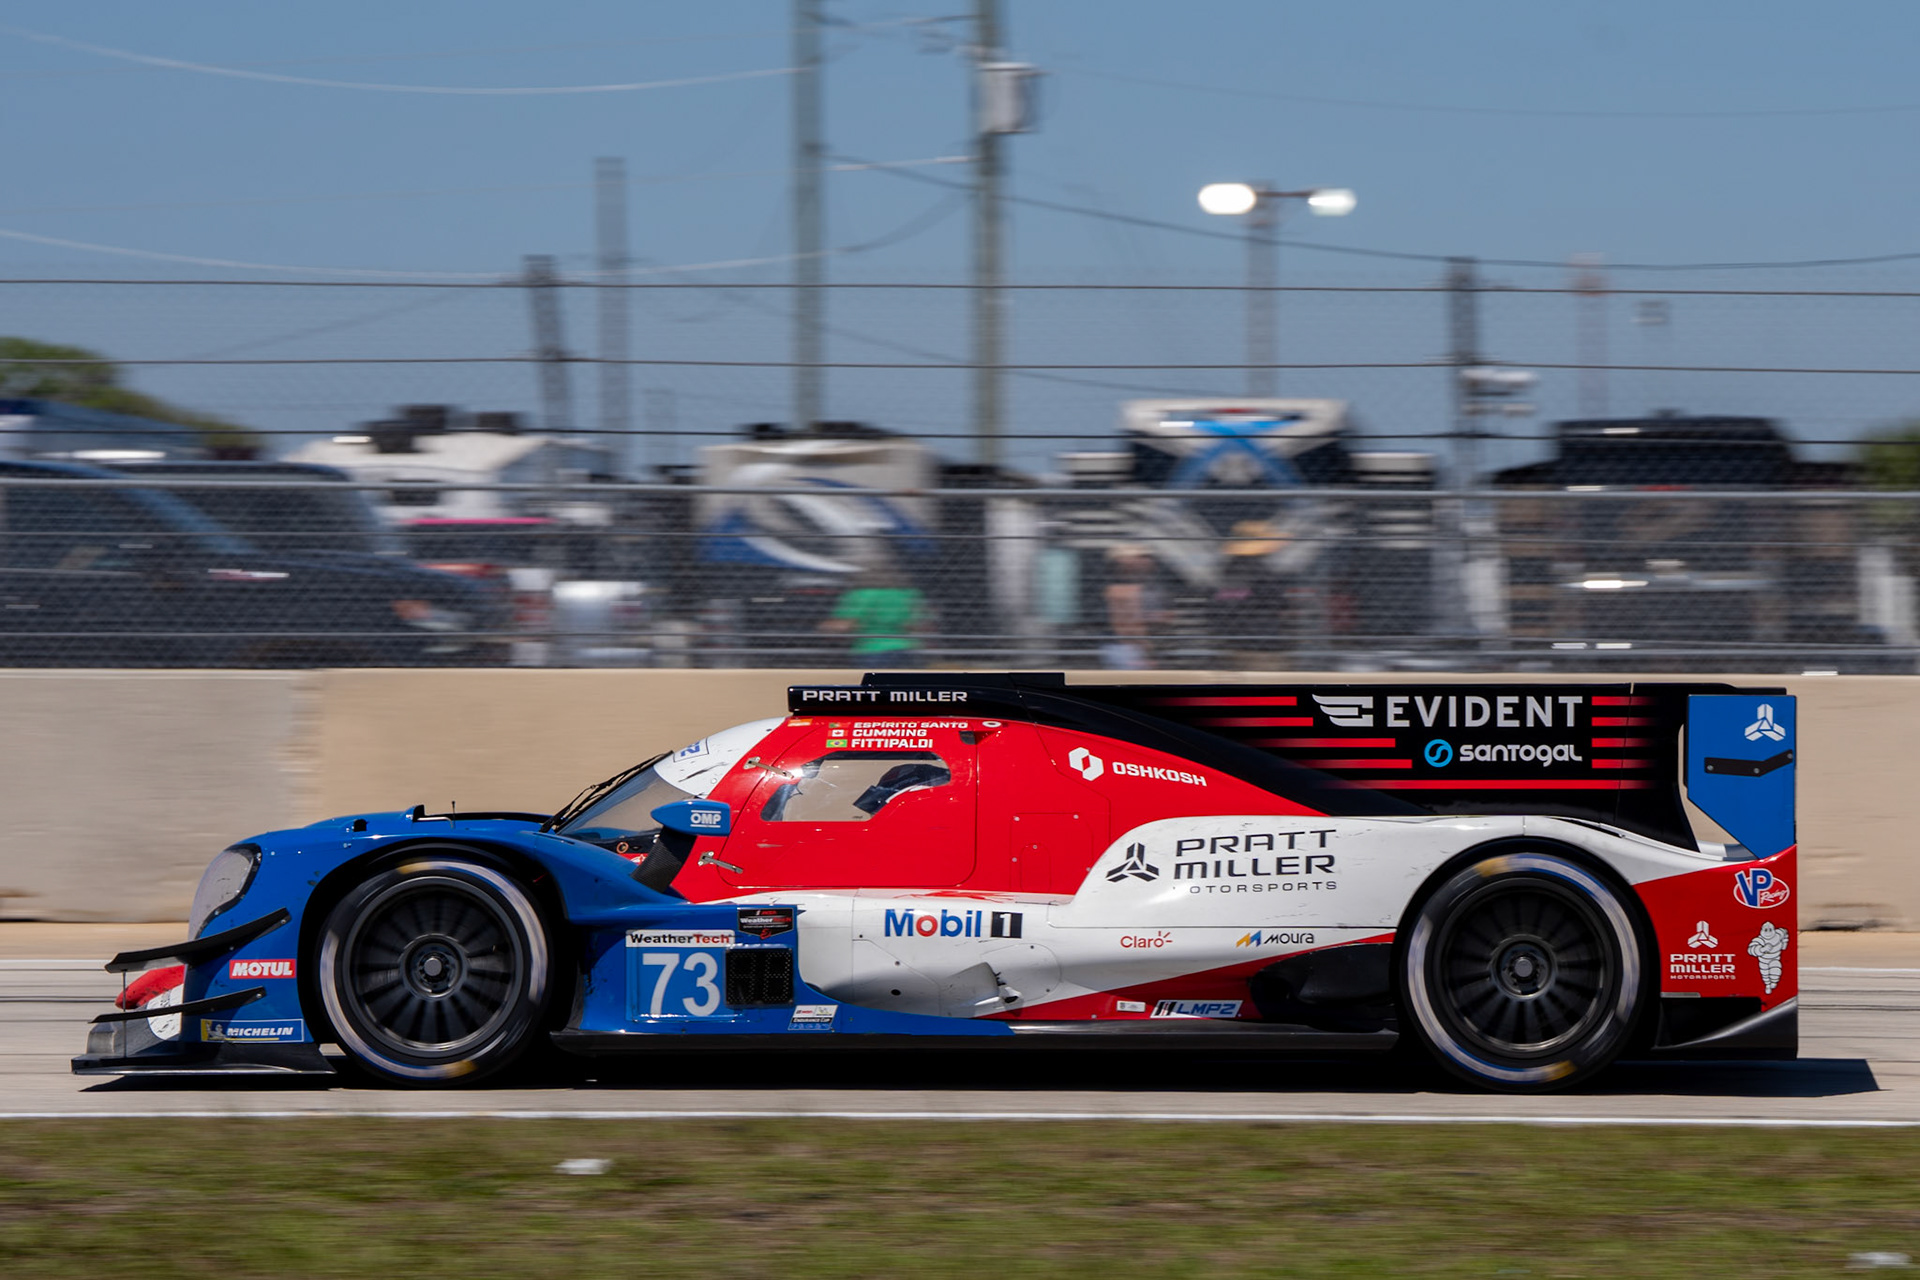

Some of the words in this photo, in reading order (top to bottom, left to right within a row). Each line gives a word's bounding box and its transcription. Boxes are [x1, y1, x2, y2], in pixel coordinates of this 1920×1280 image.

[802, 690, 881, 701] PRATT
[890, 691, 968, 702] MILLER
[1386, 696, 1583, 727] EVIDENT
[921, 721, 969, 729] SANTO
[852, 729, 927, 737] CUMMING
[851, 738, 934, 748] FITTIPALDI
[1112, 761, 1207, 786] OSHKOSH
[690, 813, 722, 825] OMP
[1176, 829, 1337, 857] PRATT
[1174, 855, 1335, 879] MILLER
[1189, 880, 1337, 893] OTORSPORTS
[1734, 868, 1774, 907] VP
[1760, 889, 1788, 903] Racing
[884, 908, 983, 937] Mobil
[630, 933, 730, 944] WeatherTech
[1120, 934, 1165, 948] Claro
[1670, 953, 1736, 962] PRATT
[232, 962, 293, 976] MOTUL
[1670, 964, 1736, 973] MILLER
[642, 952, 720, 1017] 73
[1174, 1003, 1237, 1015] LMP2
[227, 1027, 294, 1036] MICHELIN
